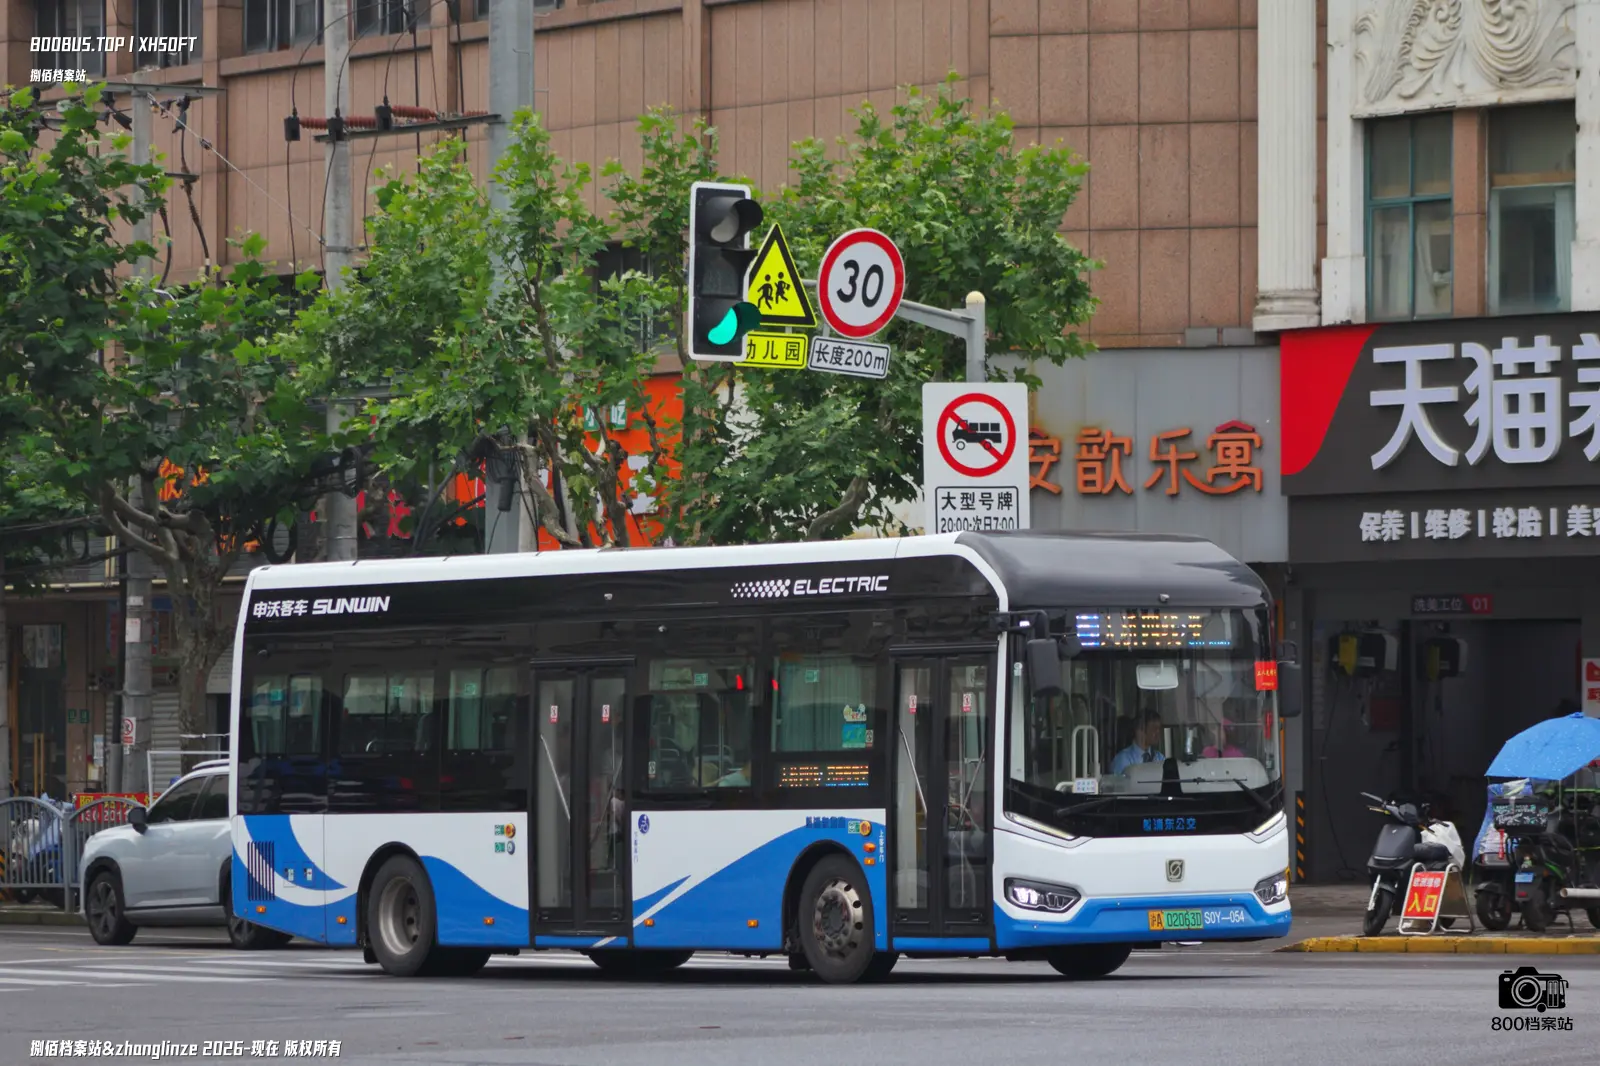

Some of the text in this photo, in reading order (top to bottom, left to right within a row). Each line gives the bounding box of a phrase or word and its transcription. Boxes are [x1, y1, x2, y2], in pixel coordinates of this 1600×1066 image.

[836, 259, 884, 308] 30
[815, 342, 886, 371] 长度200m
[1029, 420, 1262, 495] 安歆乐寓
[941, 491, 1014, 511] 大型号牌
[1359, 509, 1405, 542] 保养
[1424, 508, 1472, 540] 维修
[1492, 506, 1543, 539] 轮胎
[793, 575, 889, 596] ELECTRIC
[252, 595, 391, 619] 申沃客车 SUNWIN
[1472, 597, 1489, 611] 01
[1407, 892, 1438, 913] 入口
